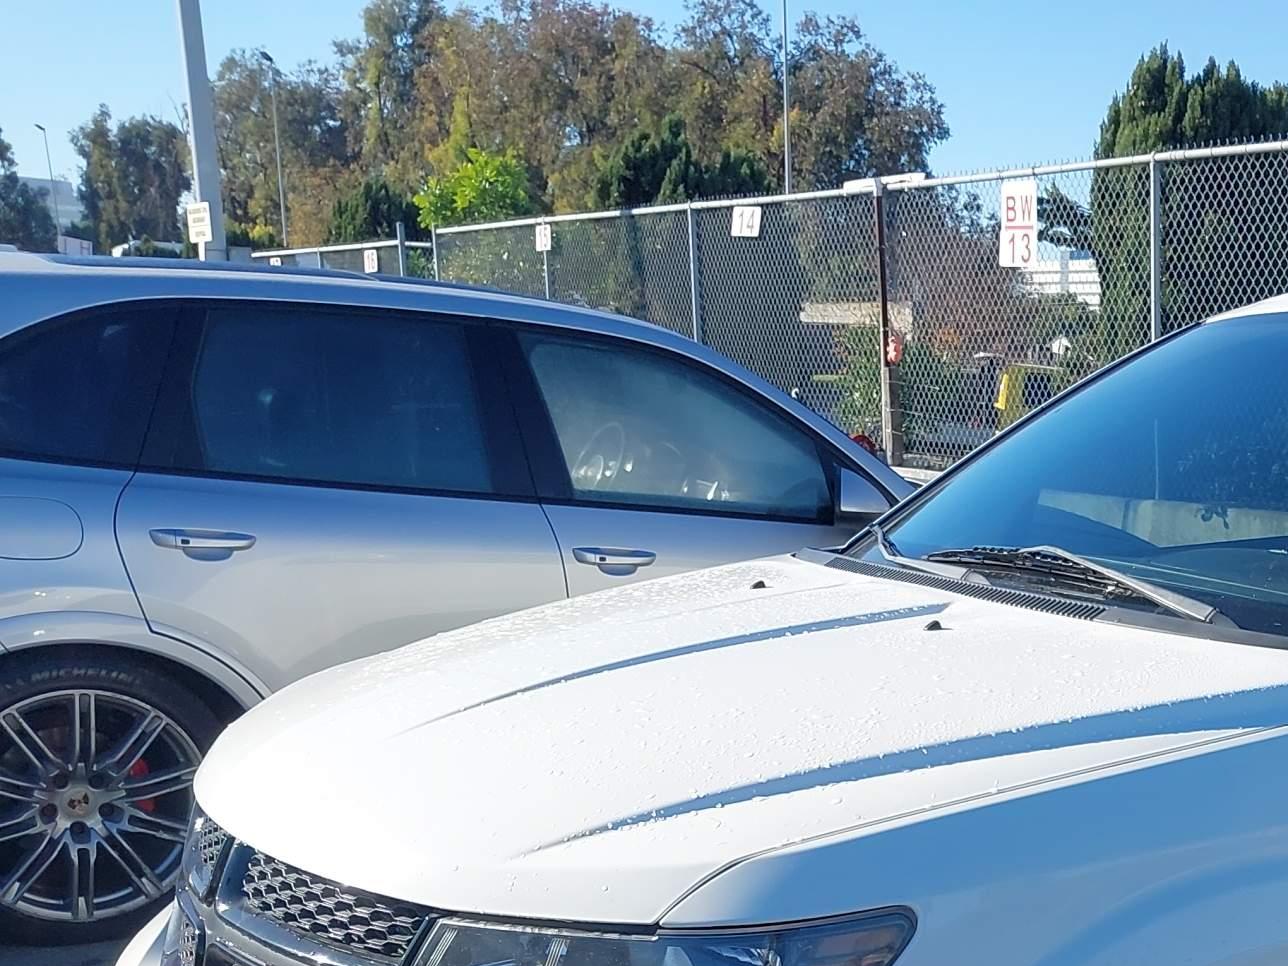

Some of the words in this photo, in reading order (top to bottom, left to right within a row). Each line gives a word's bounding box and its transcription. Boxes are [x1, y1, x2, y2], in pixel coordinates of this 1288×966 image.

[738, 209, 755, 234] 14
[1006, 195, 1033, 222] BW
[1008, 233, 1032, 264] 13
